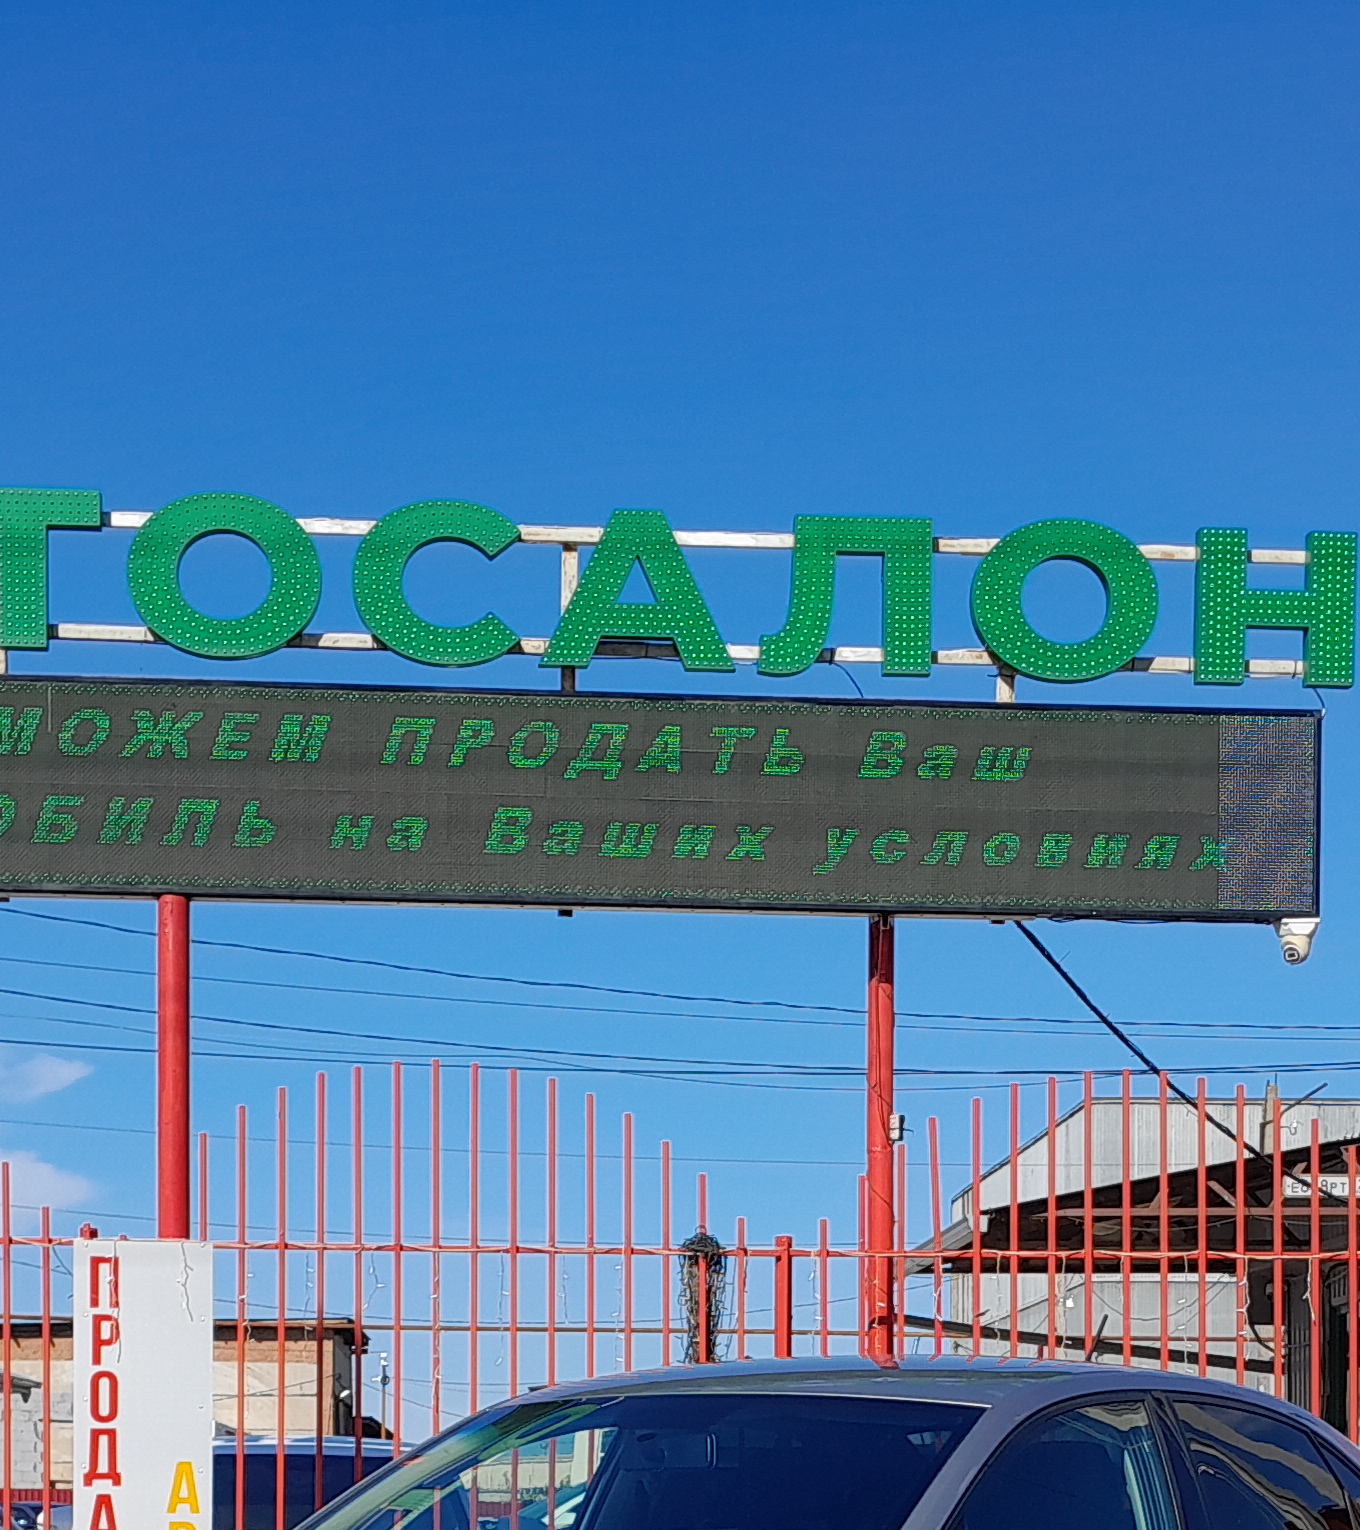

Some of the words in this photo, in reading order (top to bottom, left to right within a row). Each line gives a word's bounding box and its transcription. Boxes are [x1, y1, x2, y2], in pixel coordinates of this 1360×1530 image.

[380, 715, 806, 780] ПРОДАТЬ
[856, 729, 1033, 781] Ваш
[328, 812, 429, 852] на
[482, 805, 774, 862] Ваших
[811, 827, 1230, 876] условиях
